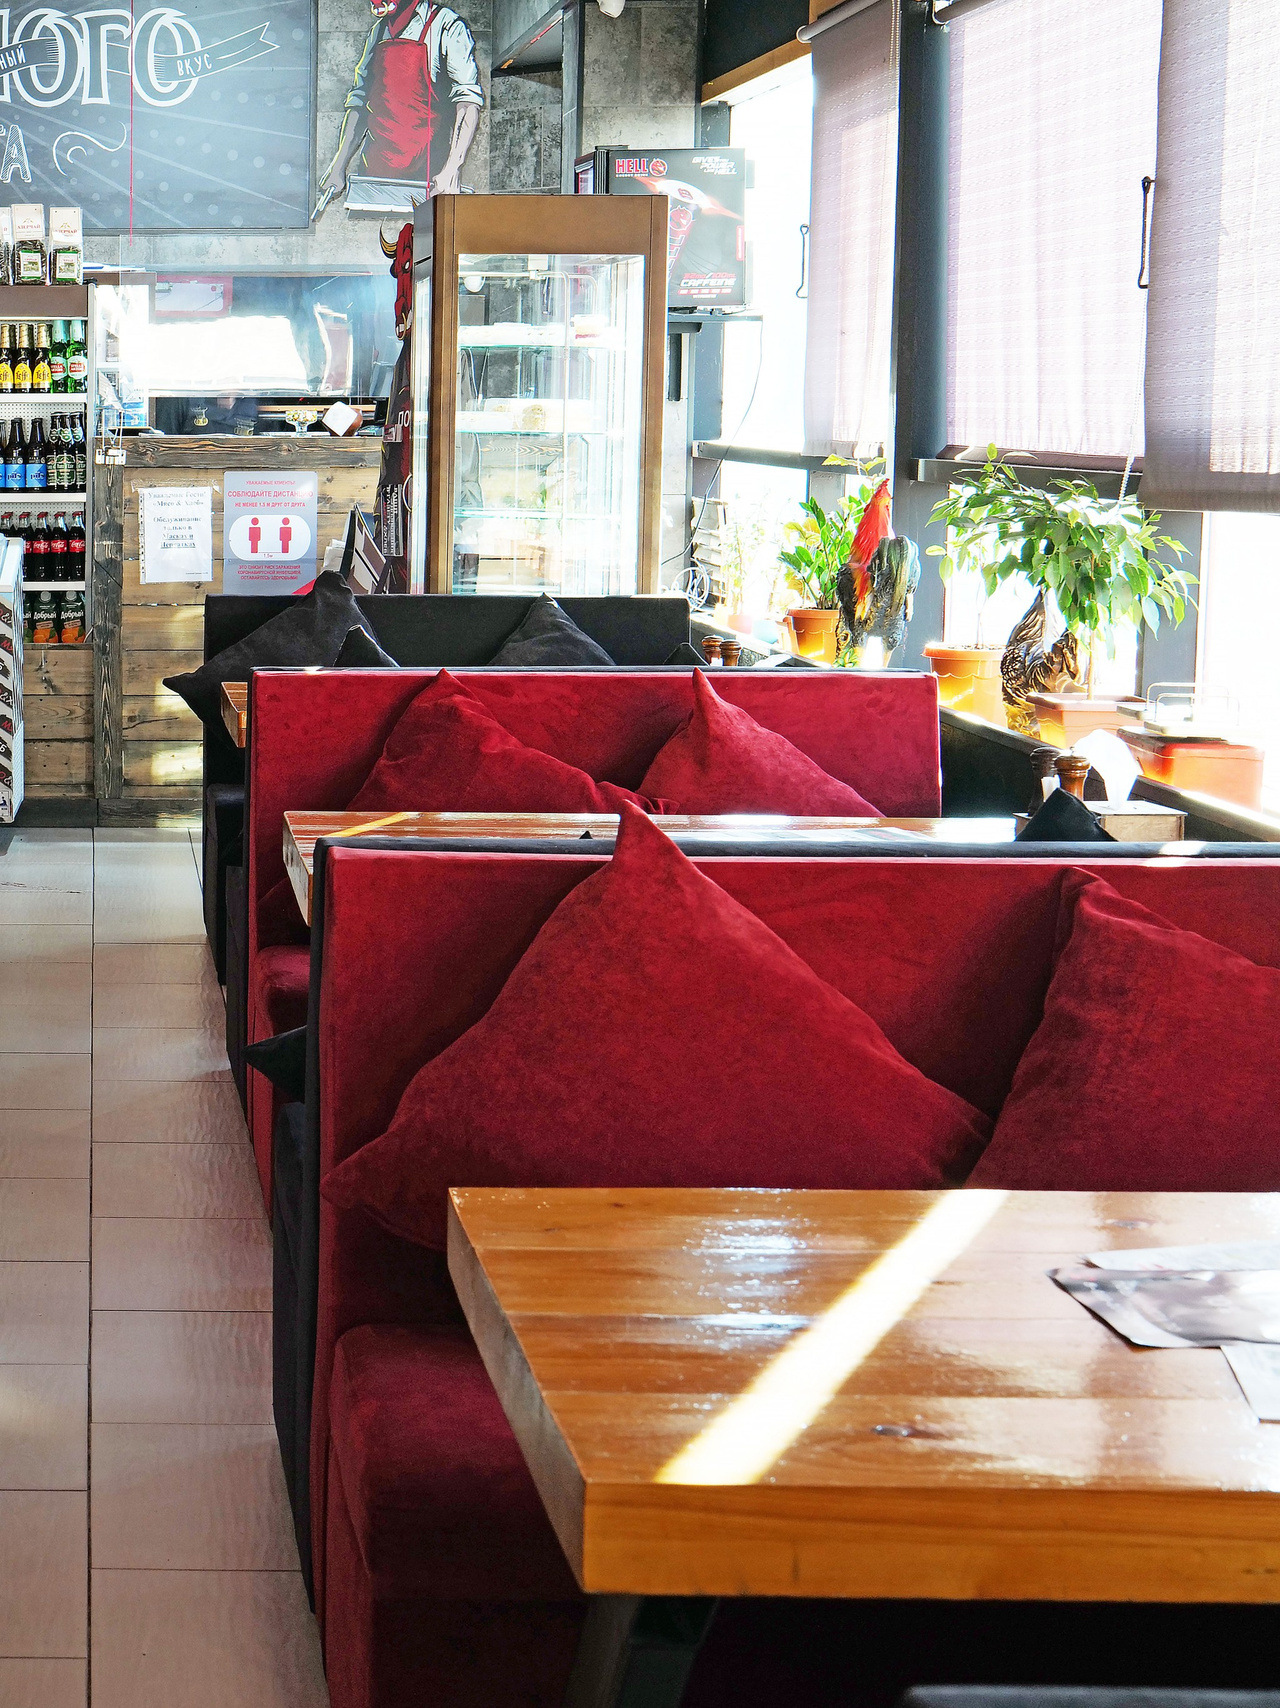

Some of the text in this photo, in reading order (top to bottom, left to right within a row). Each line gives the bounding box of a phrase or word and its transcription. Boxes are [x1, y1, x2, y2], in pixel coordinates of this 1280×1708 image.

[176, 53, 212, 77] ВКУС
[615, 158, 649, 173] HELL
[227, 489, 314, 498] СОБЛЮДАЙТЕ ДИСТАНЦЮ
[33, 610, 57, 620] Добрый
[60, 610, 84, 620] Добрый
